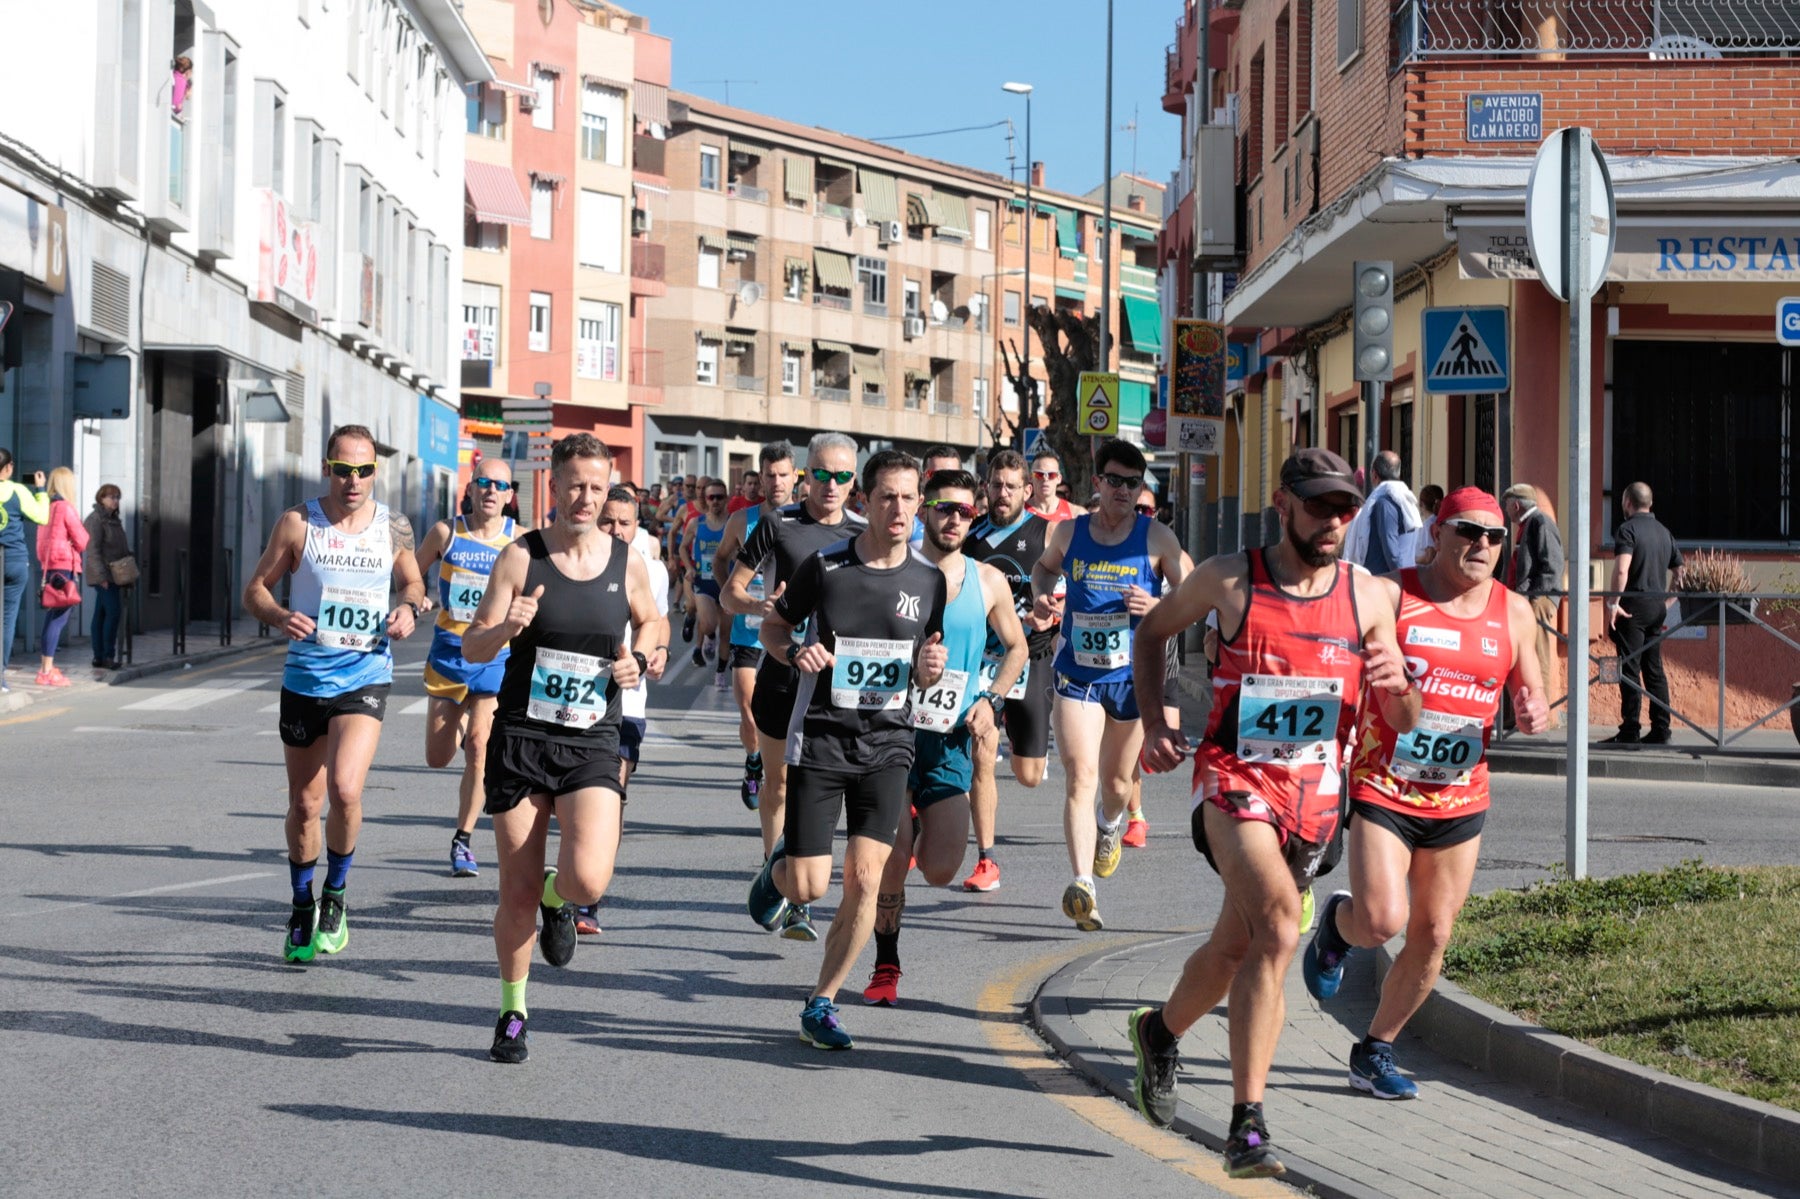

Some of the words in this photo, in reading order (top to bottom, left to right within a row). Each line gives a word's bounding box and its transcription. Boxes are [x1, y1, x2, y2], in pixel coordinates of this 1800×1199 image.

[1485, 96, 1538, 107] AVENIDA
[1488, 108, 1534, 122] JACOBO
[1471, 123, 1538, 138] CAMARERO
[1656, 236, 1800, 272] RESTA
[1092, 415, 1105, 424] 20
[315, 553, 382, 568] MARACENA
[1089, 560, 1138, 577] olimpo
[325, 605, 380, 632] 1031
[1081, 630, 1120, 650] 393
[847, 661, 899, 687] 929
[1433, 667, 1476, 682] Clínicas
[545, 674, 596, 705] 852
[917, 688, 957, 710] 143
[1256, 704, 1324, 736] 412
[1410, 733, 1469, 764] 560
